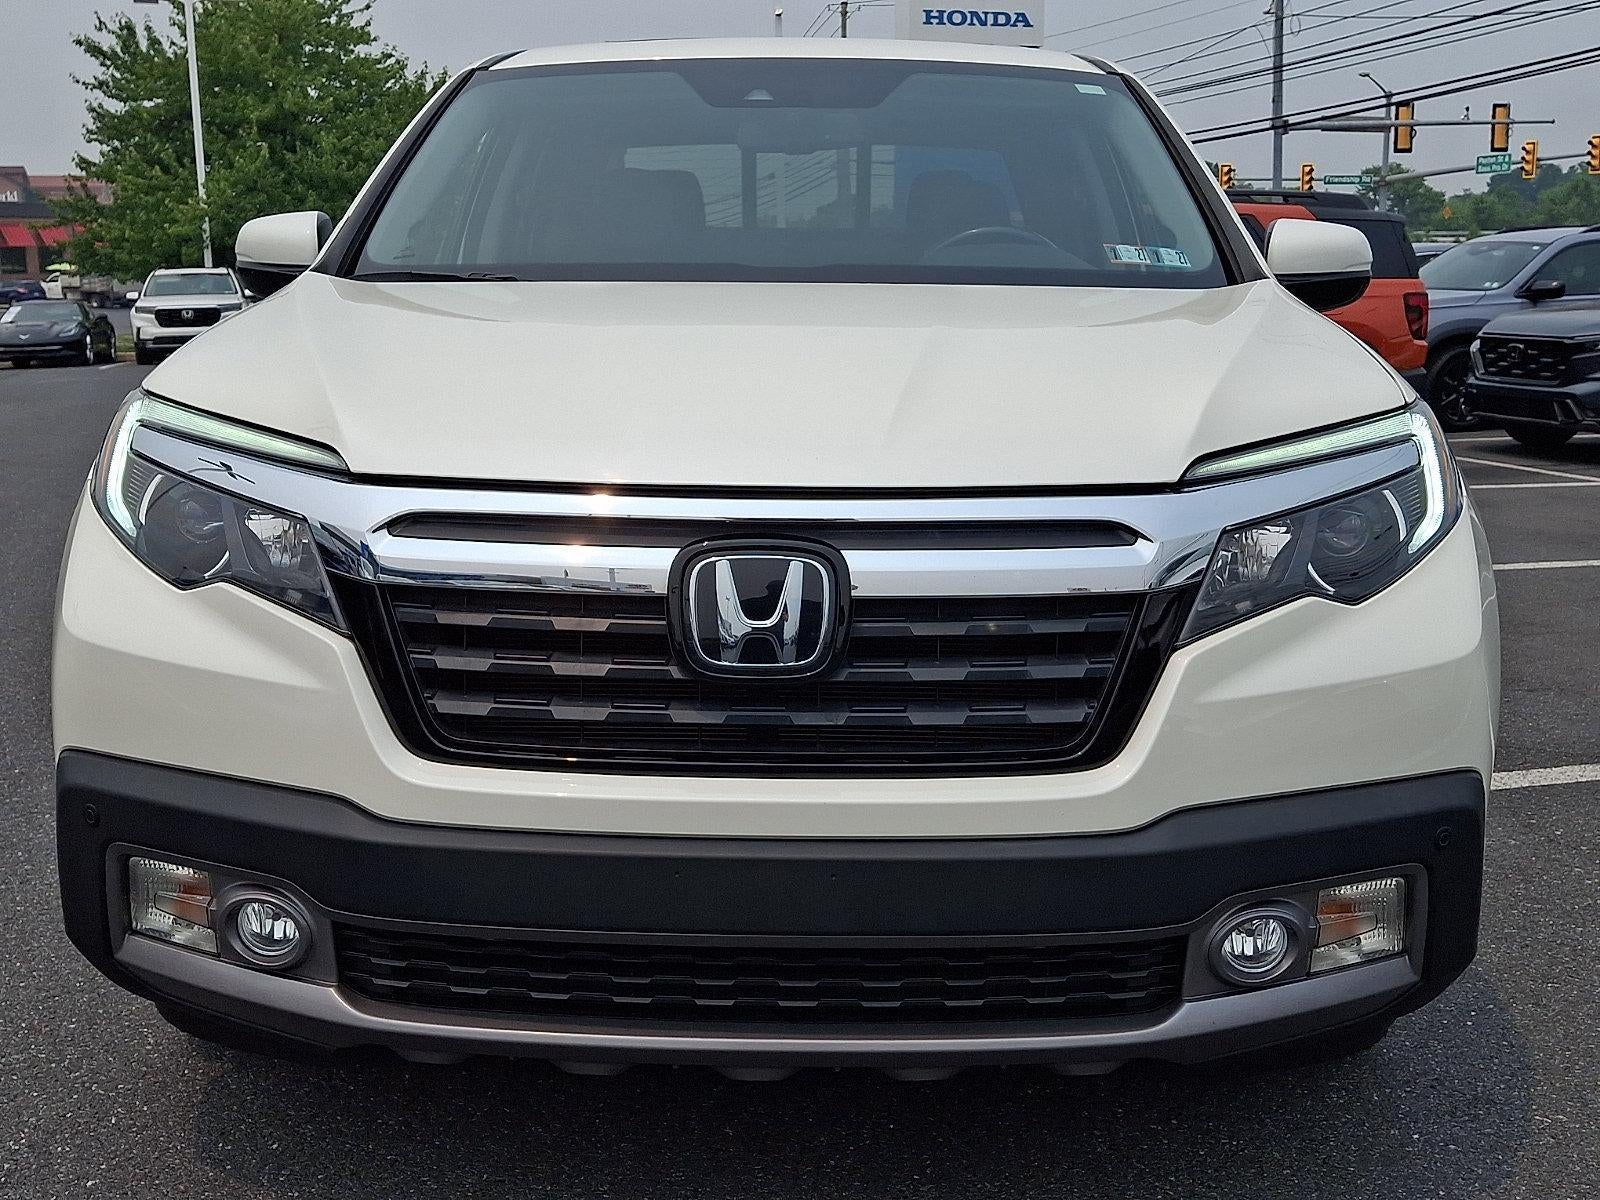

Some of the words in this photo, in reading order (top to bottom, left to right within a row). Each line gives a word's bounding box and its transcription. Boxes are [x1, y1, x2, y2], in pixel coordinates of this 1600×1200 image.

[922, 9, 1034, 29] HONDA
[1325, 175, 1360, 184] Friendship
[1361, 175, 1371, 183] Rd
